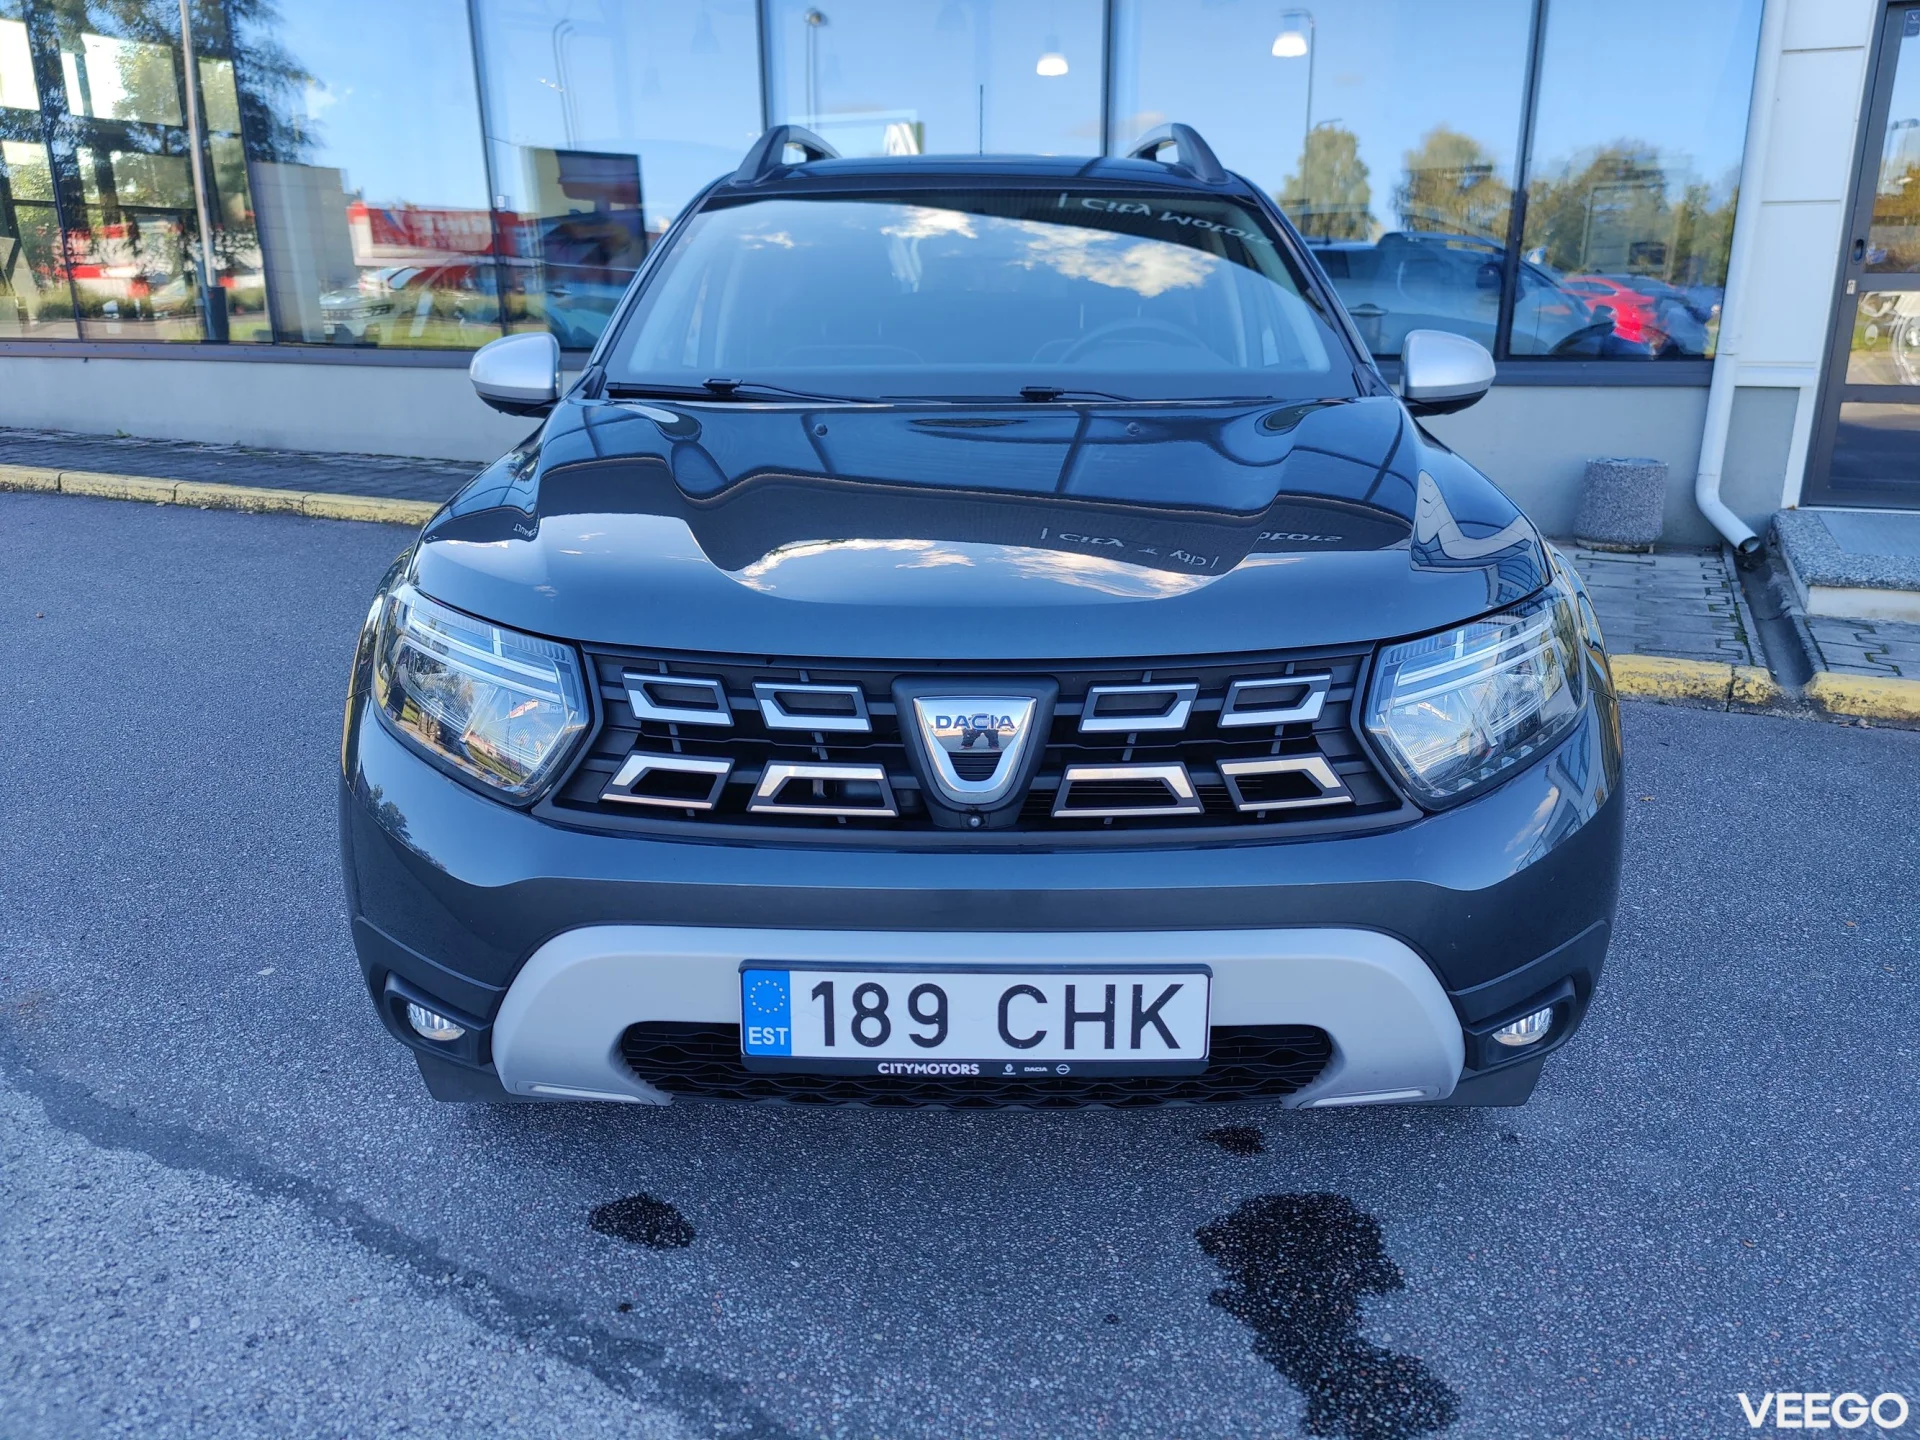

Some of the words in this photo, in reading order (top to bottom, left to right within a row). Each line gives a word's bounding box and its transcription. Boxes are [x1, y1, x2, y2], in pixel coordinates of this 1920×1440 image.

[935, 715, 1015, 729] DACIA
[811, 980, 949, 1048] 189
[997, 983, 1184, 1050] CHK
[748, 1026, 789, 1045] EST
[877, 1062, 980, 1075] CITYMOTORS
